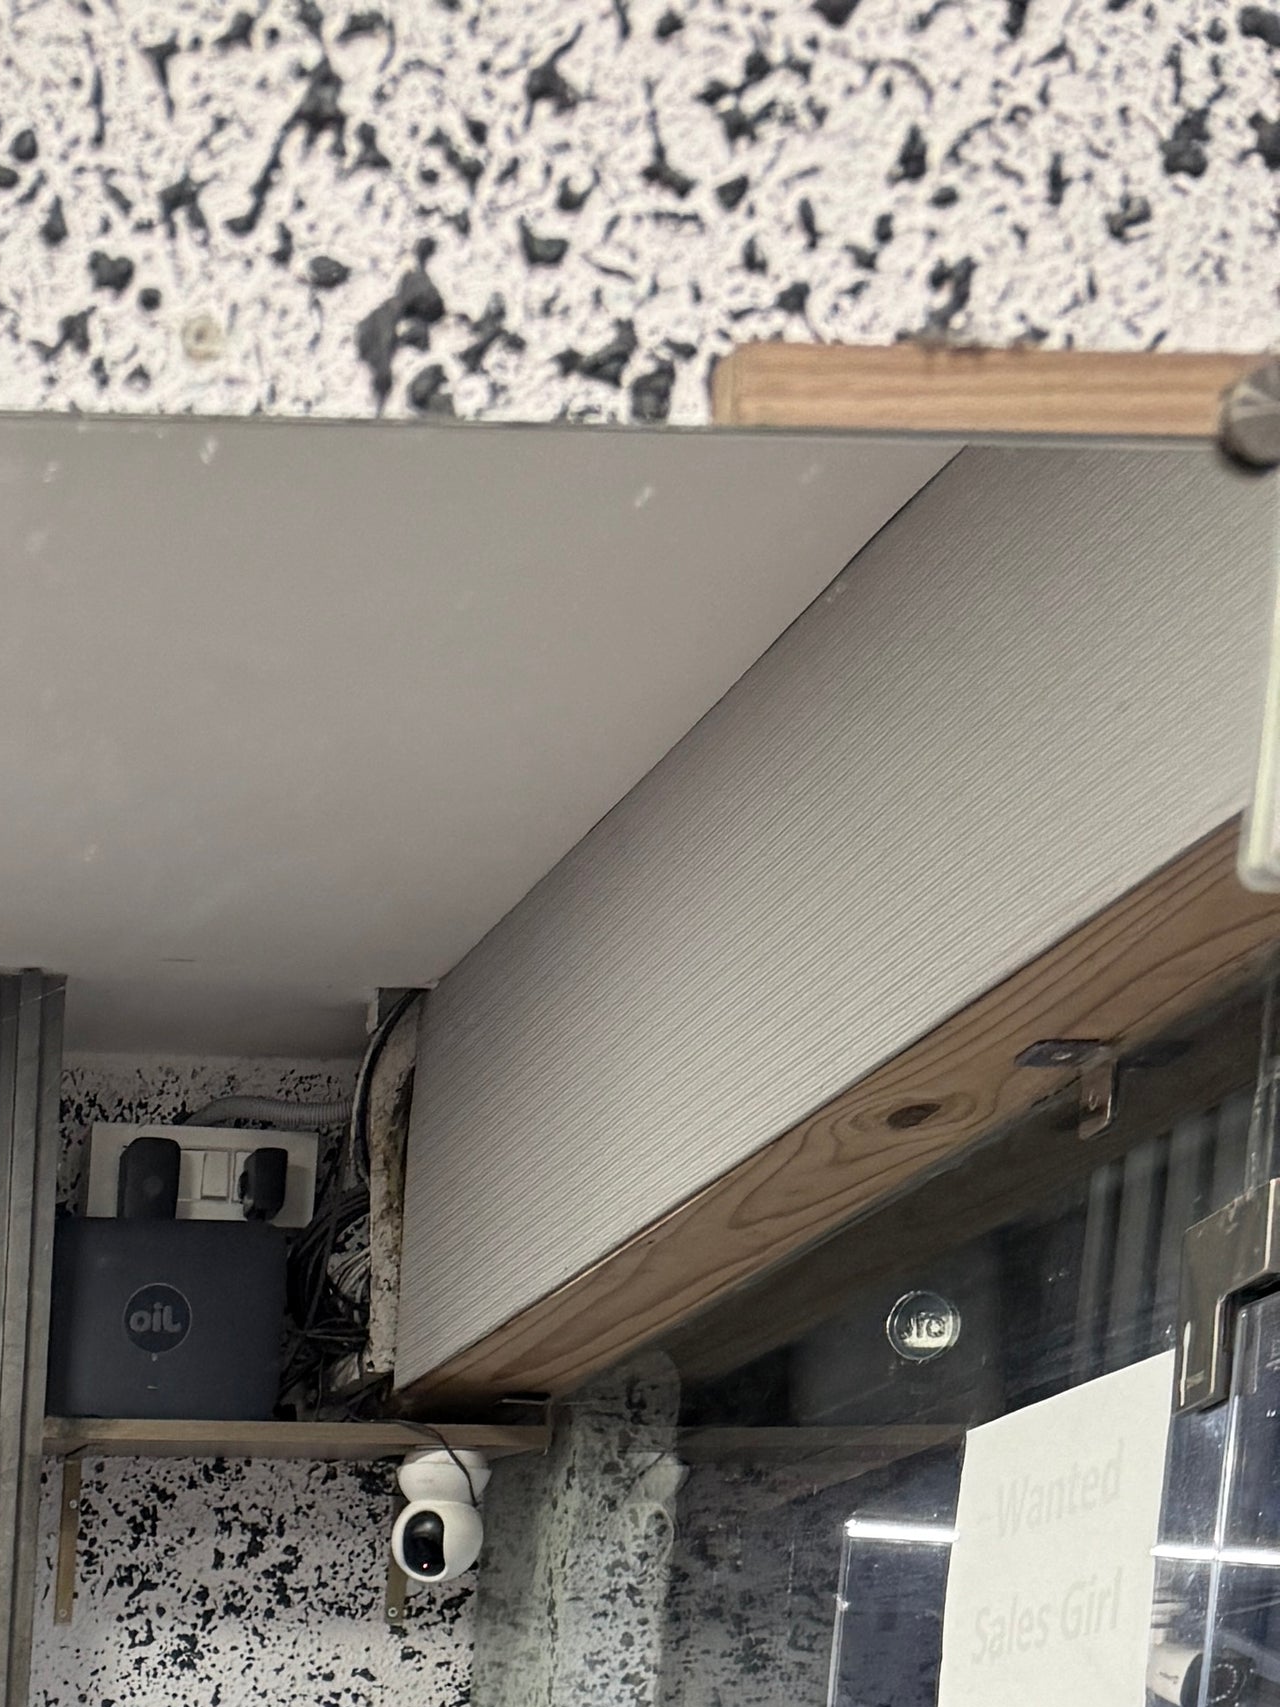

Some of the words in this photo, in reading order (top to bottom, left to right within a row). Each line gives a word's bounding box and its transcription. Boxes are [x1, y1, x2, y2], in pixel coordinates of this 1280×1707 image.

[995, 1437, 1124, 1541] Wanted
[972, 1597, 1051, 1667] Sales
[1060, 1565, 1124, 1643] Girl
